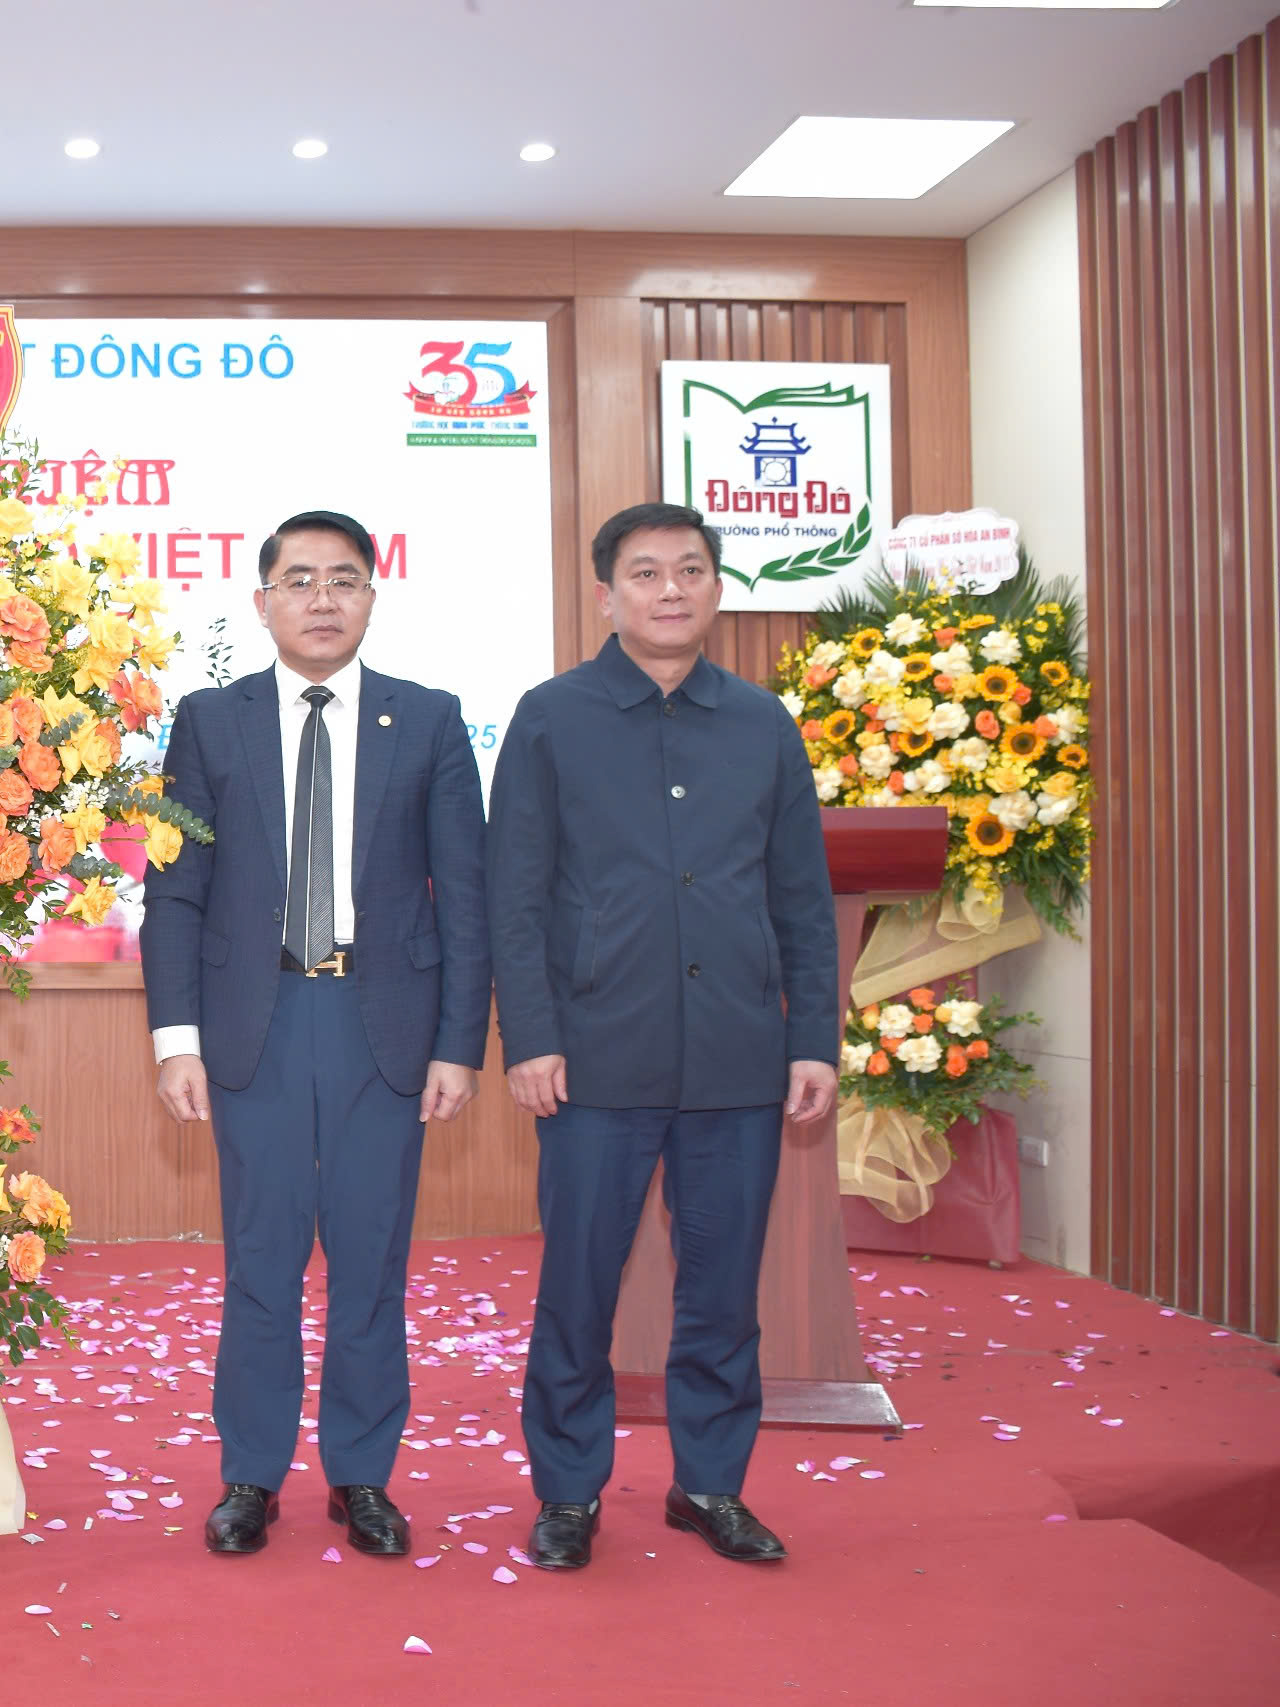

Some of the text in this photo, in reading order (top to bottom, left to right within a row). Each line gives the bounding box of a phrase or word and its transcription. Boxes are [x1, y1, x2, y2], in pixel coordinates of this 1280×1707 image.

[51, 334, 202, 379] ĐÔNG
[220, 334, 294, 379] ĐÔ
[420, 340, 516, 405] 35
[704, 479, 851, 519] Đông Đô
[712, 521, 838, 538] RƯỜNG PHỔ THÔNG
